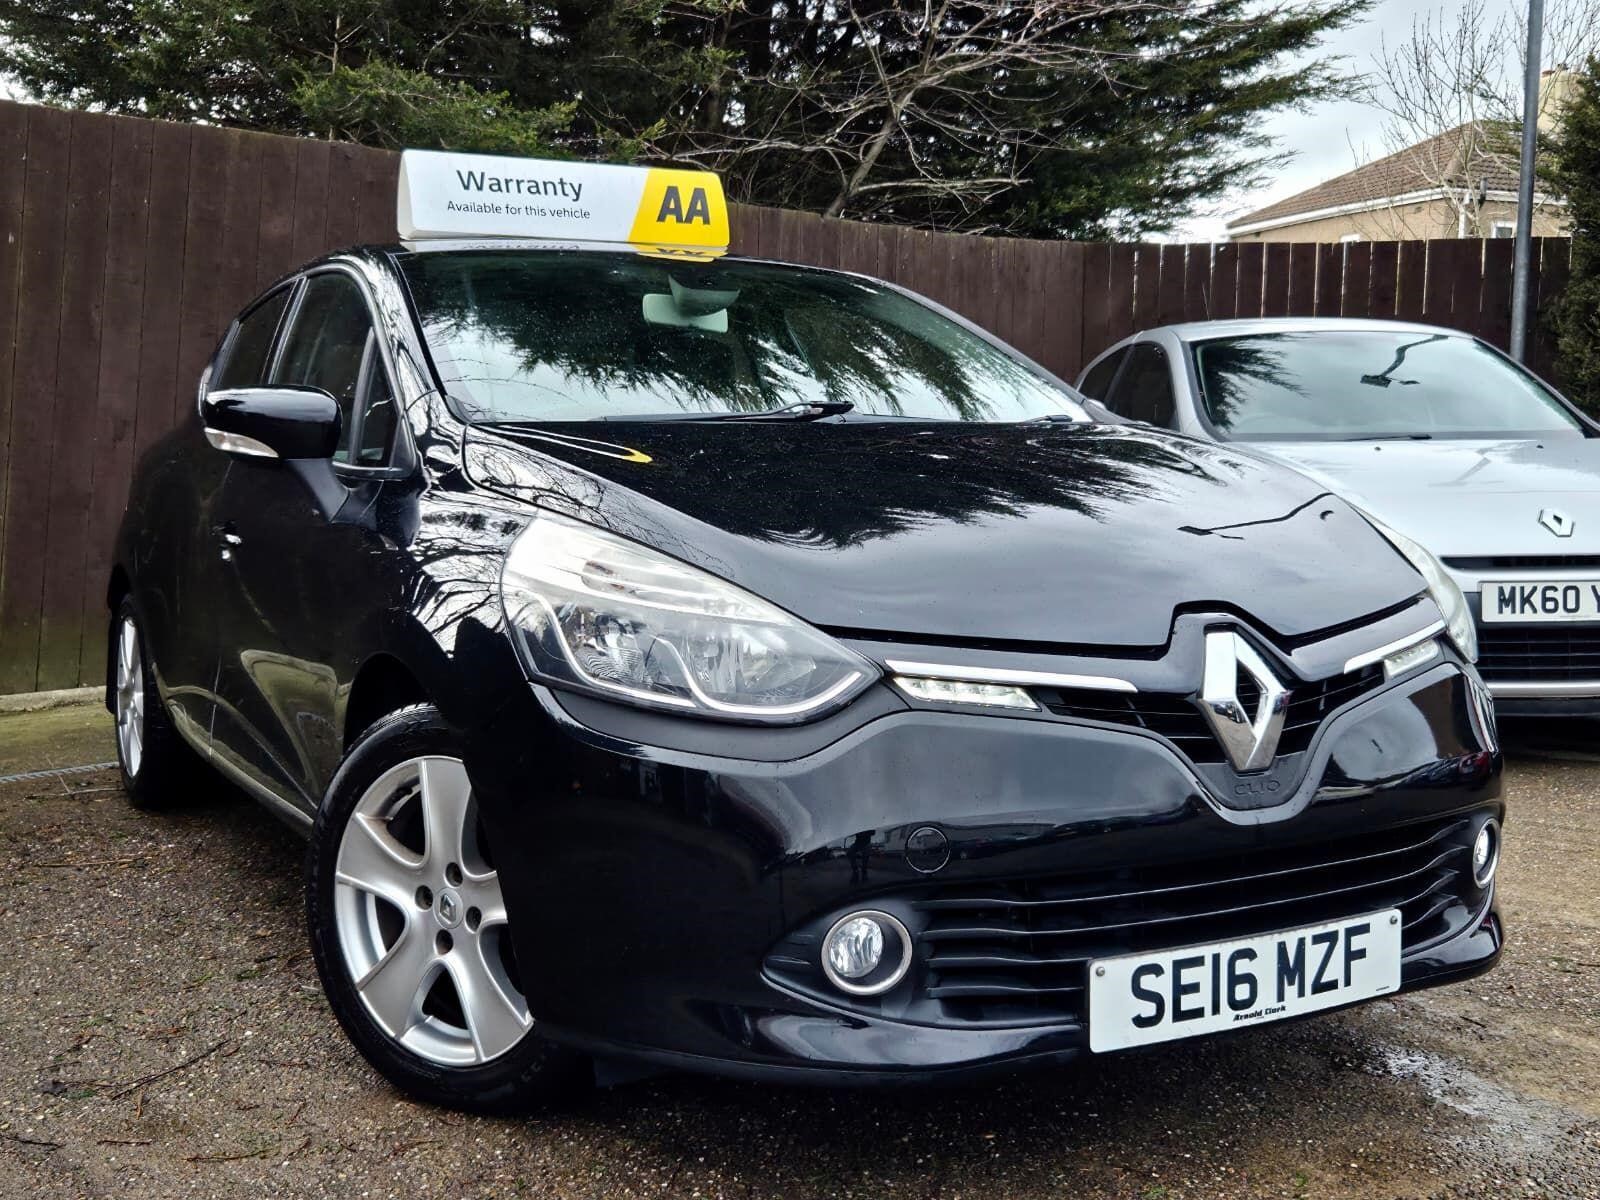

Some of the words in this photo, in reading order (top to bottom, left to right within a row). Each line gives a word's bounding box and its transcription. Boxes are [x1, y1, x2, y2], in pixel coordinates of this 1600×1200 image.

[456, 169, 583, 202] Warranty
[447, 200, 502, 214] Available
[505, 203, 522, 215] for
[525, 205, 547, 217] this
[549, 207, 591, 219] vehicle
[656, 185, 711, 226] AA
[1497, 585, 1580, 615] MK60
[1234, 780, 1280, 796] CLIO
[1131, 947, 1258, 1029] SE16
[1276, 922, 1371, 1003] MZF
